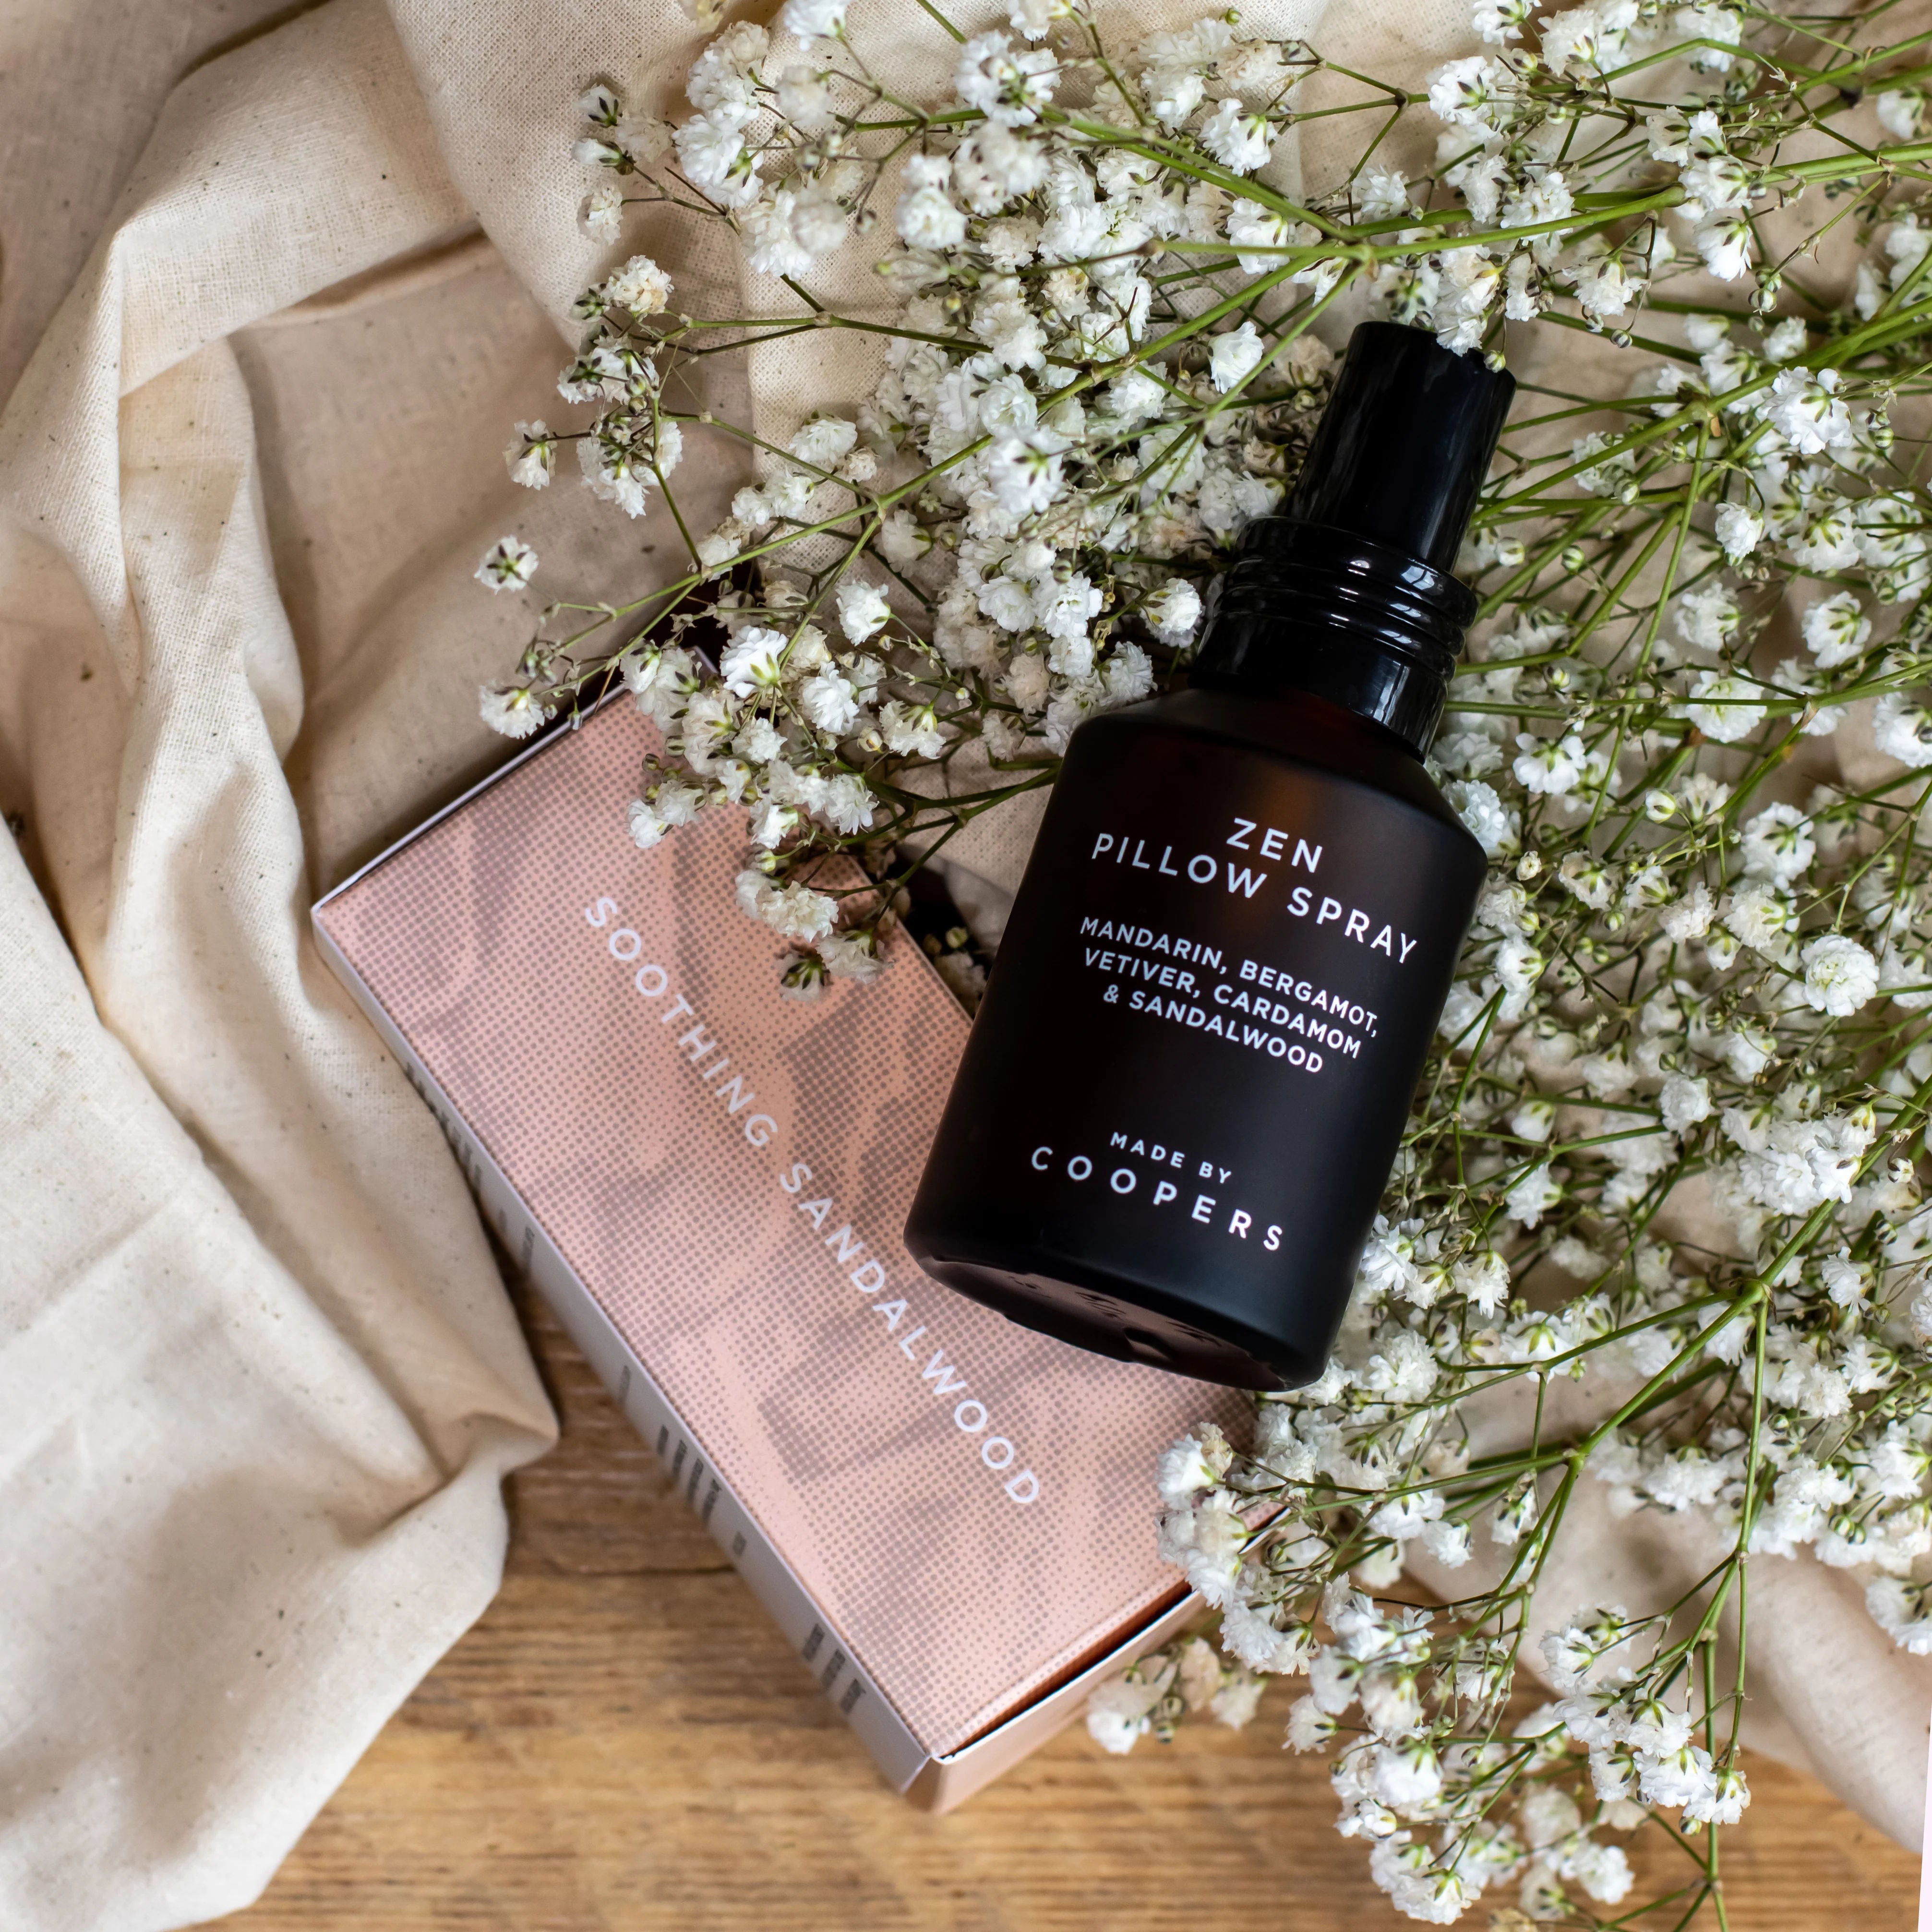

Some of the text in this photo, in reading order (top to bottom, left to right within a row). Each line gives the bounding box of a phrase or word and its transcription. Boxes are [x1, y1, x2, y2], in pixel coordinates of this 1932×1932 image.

[1091, 833, 1417, 964] PILLOW SPRAY
[1226, 817, 1323, 874] ZEN
[1080, 916, 1378, 1038] MANDARIN, BERGAMOT,
[1085, 948, 1362, 1059] VETIVER, CARDAMOM
[1103, 984, 1323, 1074] & SANDALWOOD
[584, 896, 1041, 1504] SOOTHING SANDALWOOD
[1031, 1146, 1283, 1252] COOPERS
[1110, 1131, 1232, 1185] MADE BY
